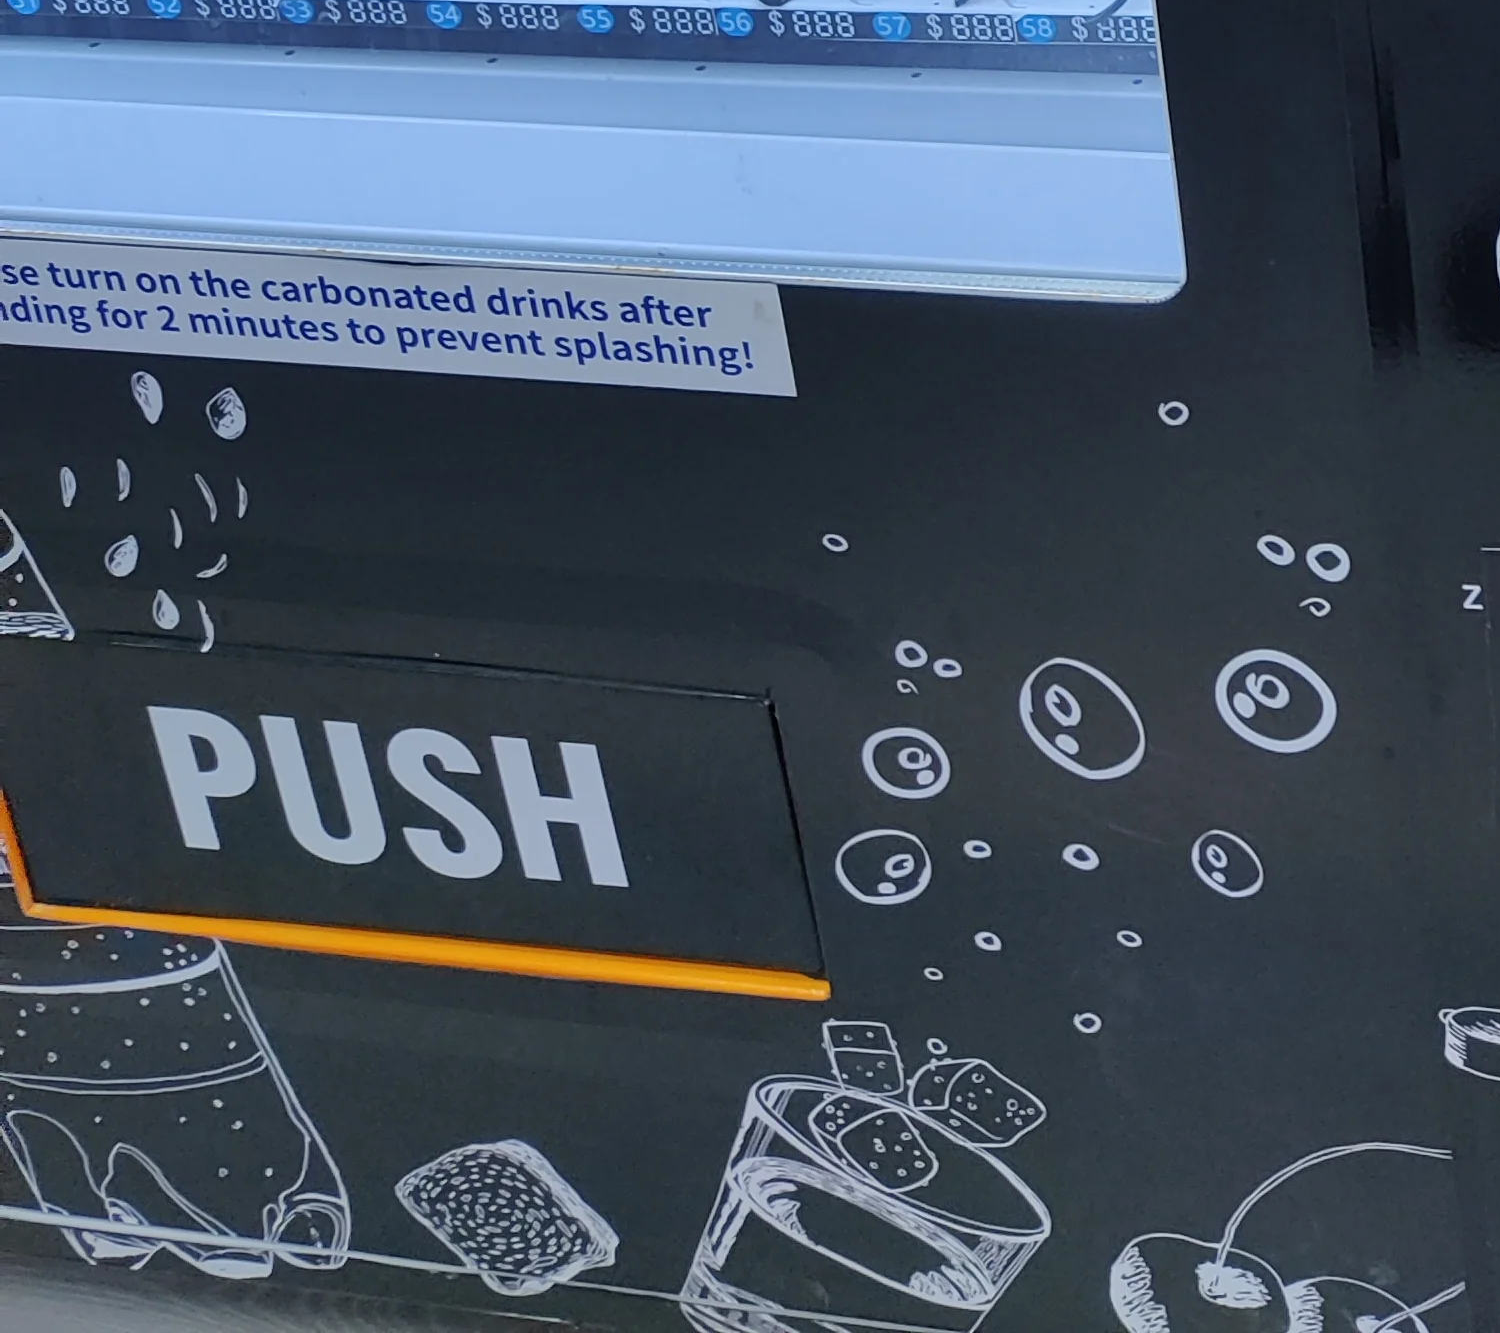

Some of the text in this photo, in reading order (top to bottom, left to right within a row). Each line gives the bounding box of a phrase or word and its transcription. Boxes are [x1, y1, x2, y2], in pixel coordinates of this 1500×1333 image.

[431, 6, 460, 25] 54
[1, 262, 711, 328] se turn on the carbonated drinks after
[96, 299, 148, 330] for
[156, 305, 181, 333] 2
[188, 307, 339, 342] minutes
[347, 318, 385, 345] to
[396, 325, 546, 357] prevent
[556, 331, 754, 375] splashing!
[146, 706, 629, 888] PUSH
